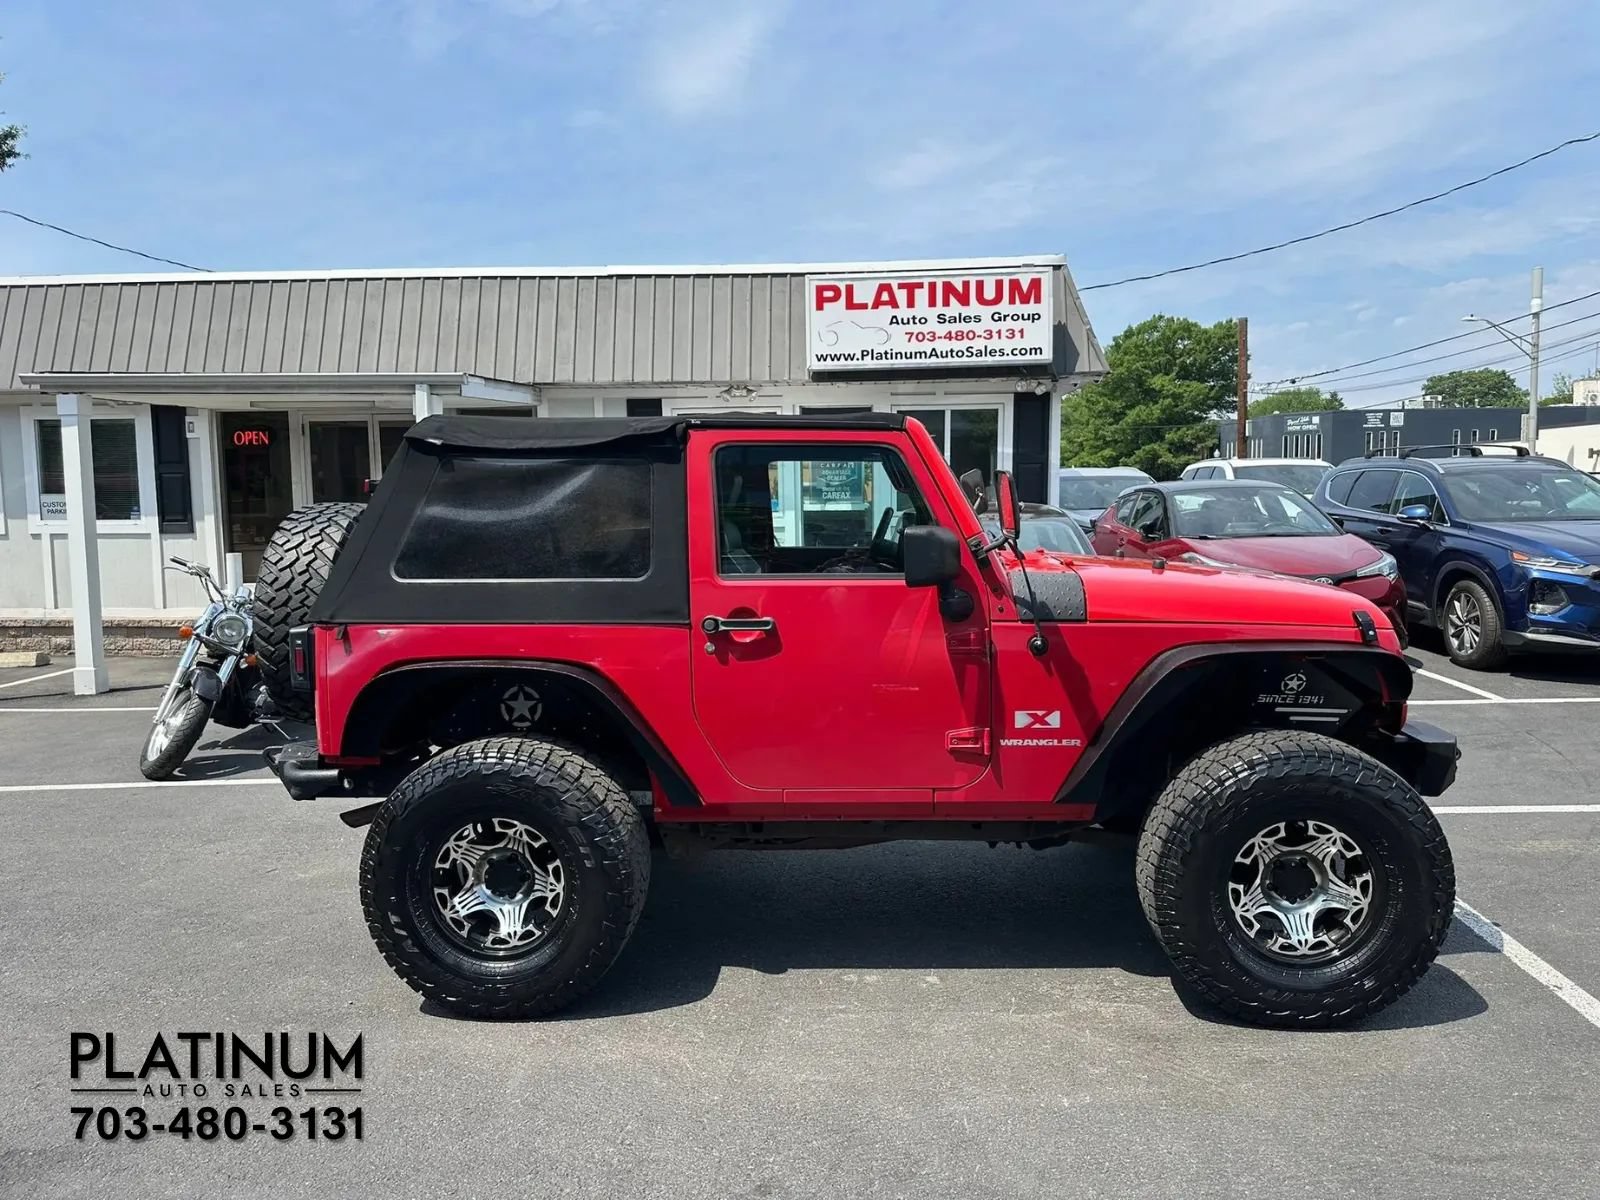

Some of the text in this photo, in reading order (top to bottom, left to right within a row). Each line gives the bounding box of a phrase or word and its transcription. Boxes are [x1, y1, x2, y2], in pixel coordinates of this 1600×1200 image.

[815, 277, 1042, 311] PLATINUM
[889, 311, 1041, 326] Auto Sales Group
[905, 328, 1025, 343] 703-480-3131
[815, 345, 1043, 362] www.PlatinumAutoSales.com
[233, 430, 269, 446] OPEN
[822, 491, 851, 499] CARFAX
[1298, 695, 1325, 704] 1941
